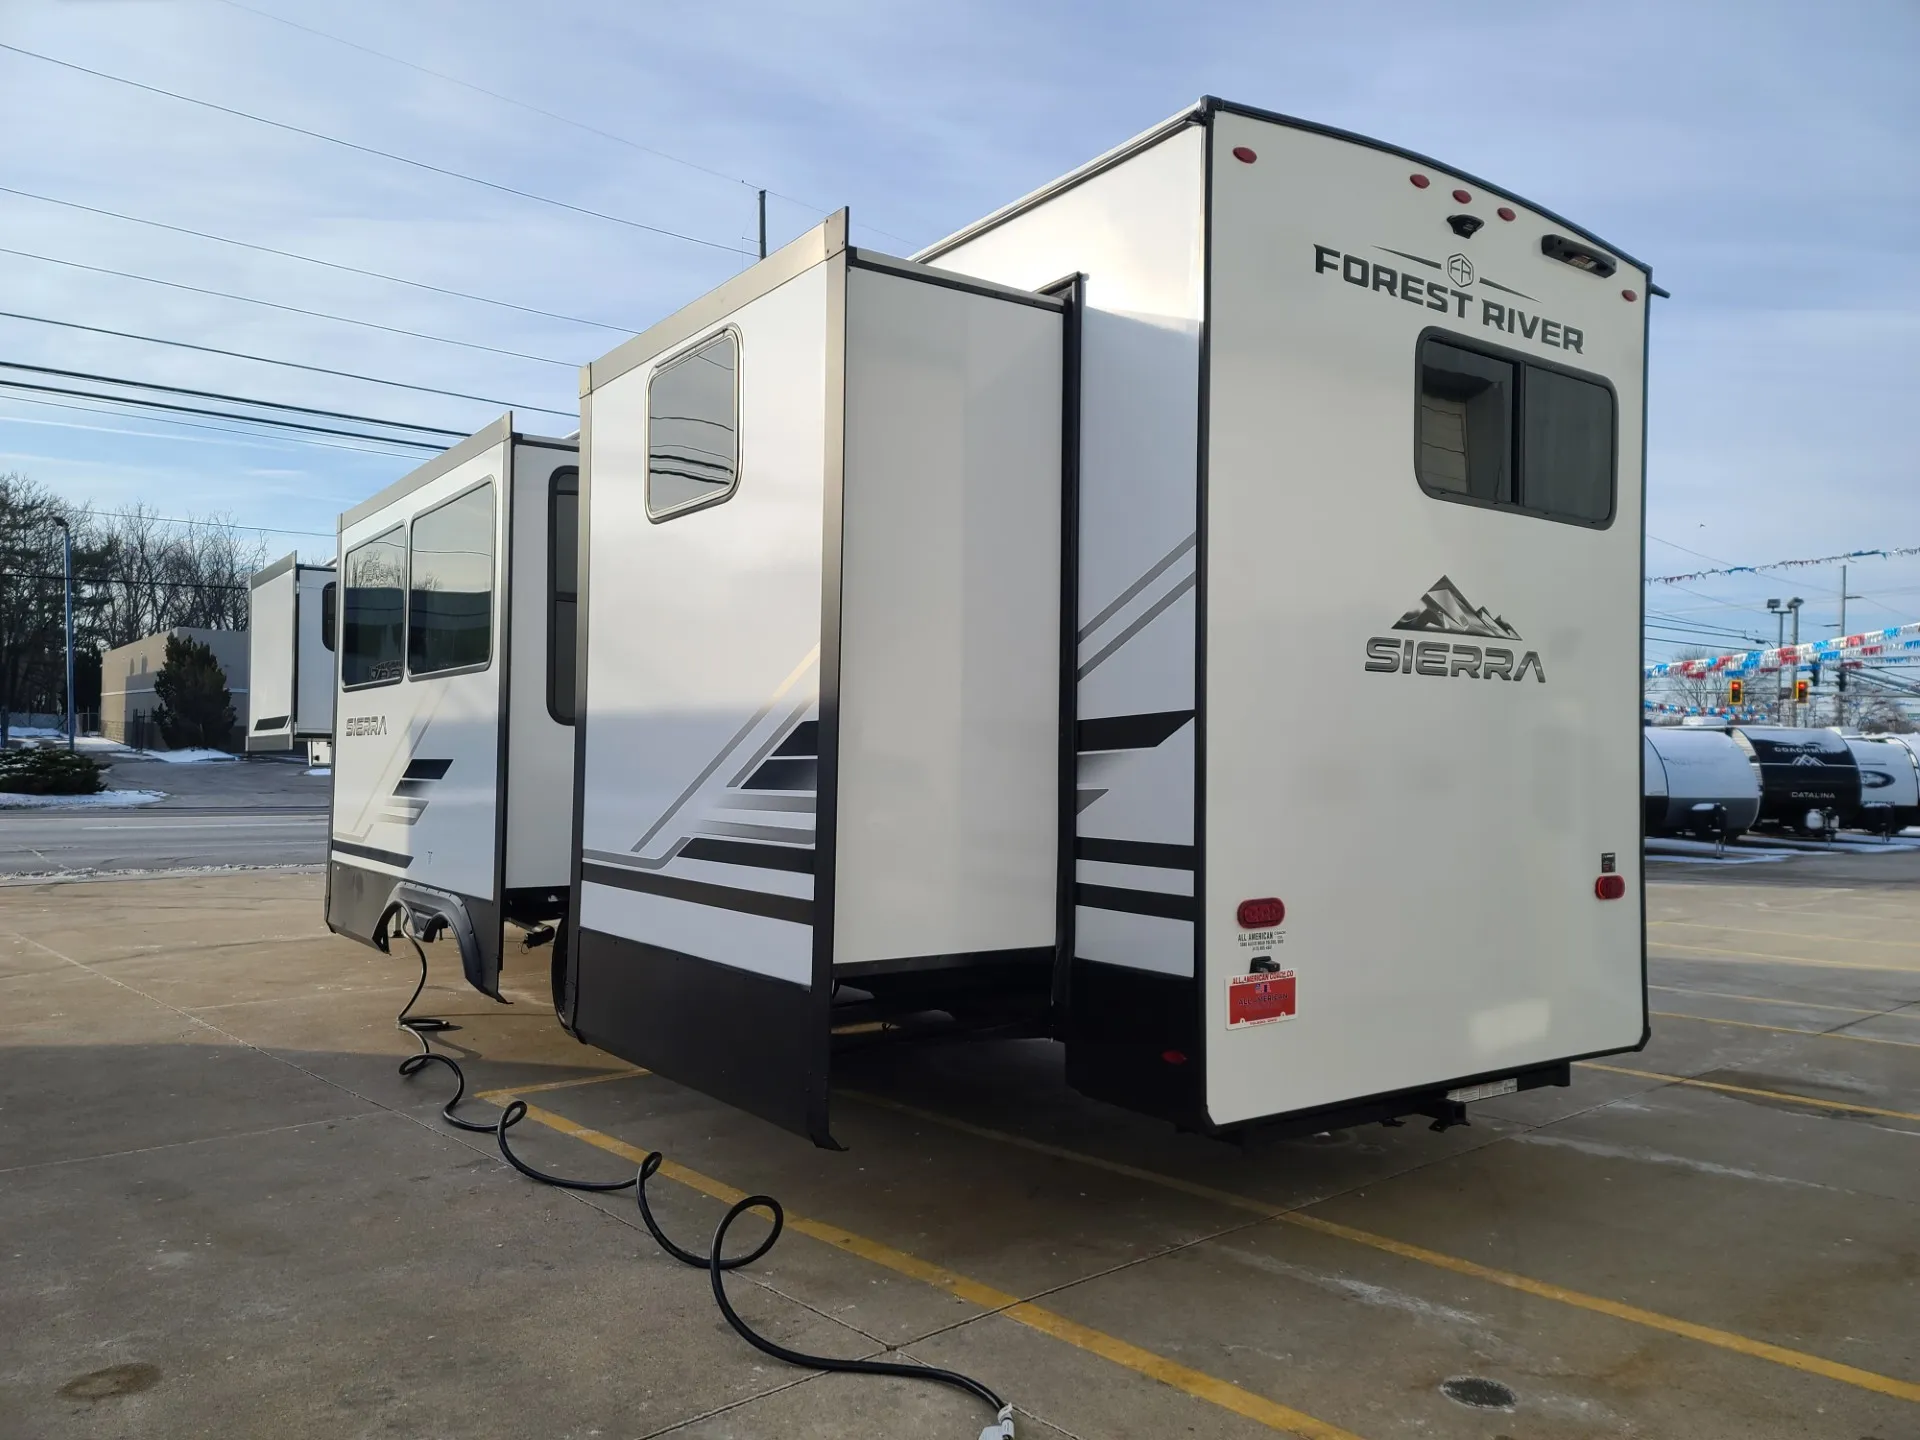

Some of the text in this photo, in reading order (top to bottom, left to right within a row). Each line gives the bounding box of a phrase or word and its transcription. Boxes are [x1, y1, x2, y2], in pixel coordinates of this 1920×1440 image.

[1313, 244, 1584, 354] FOREST RIVER
[1364, 636, 1546, 683] SIERRA
[345, 715, 387, 736] SIERRA
[1791, 791, 1836, 799] CATALINA
[1238, 933, 1247, 942] ALL
[1248, 931, 1274, 941] AMERICAN
